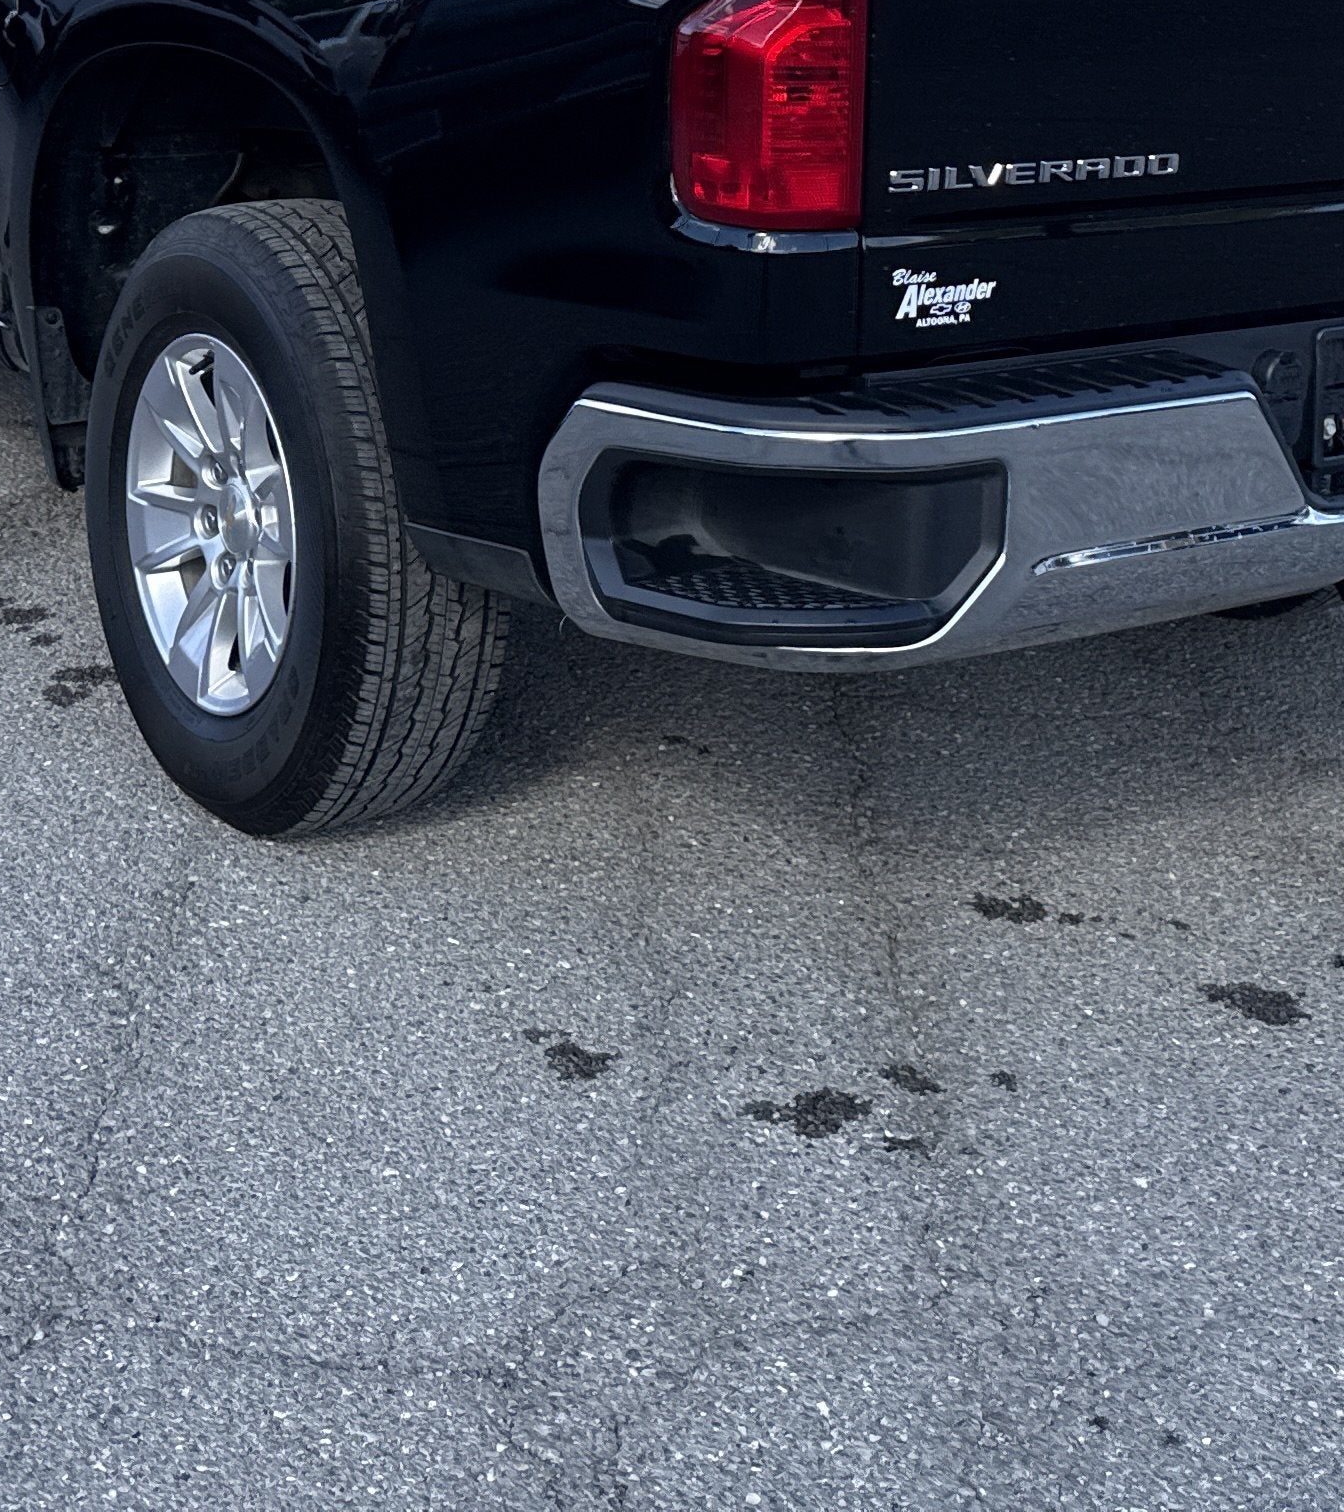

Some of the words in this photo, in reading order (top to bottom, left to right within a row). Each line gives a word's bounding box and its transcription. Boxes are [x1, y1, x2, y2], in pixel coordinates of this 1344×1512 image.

[888, 152, 1181, 194] SILVERADO
[892, 268, 937, 286] Blaise
[895, 278, 997, 319] Alexander
[959, 313, 971, 323] PA
